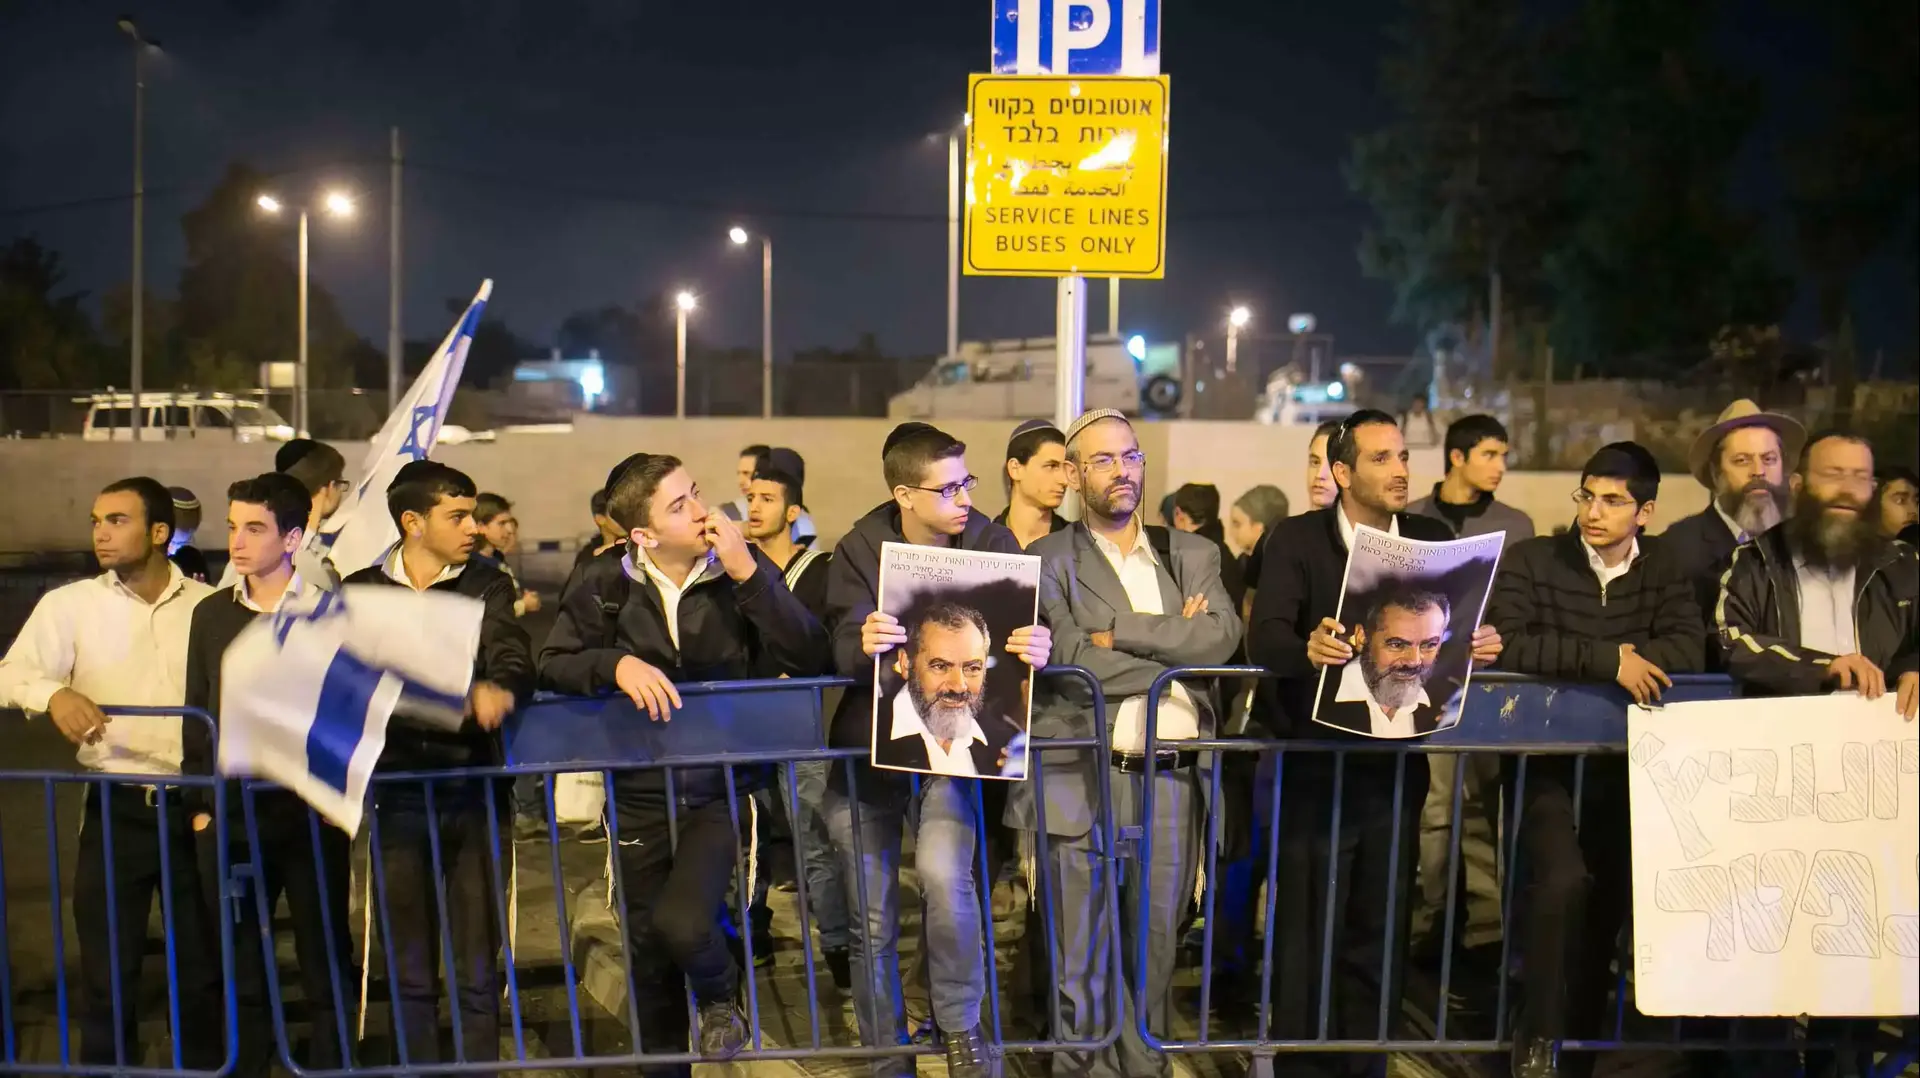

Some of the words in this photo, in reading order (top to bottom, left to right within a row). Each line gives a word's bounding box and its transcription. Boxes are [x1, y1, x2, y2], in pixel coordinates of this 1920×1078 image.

[988, 97, 1036, 120] בקווי
[1050, 97, 1152, 116] אוטובוסים
[1002, 119, 1059, 143] בלבד
[985, 207, 1076, 225] SERVICE
[1088, 208, 1150, 226] LINES
[995, 234, 1066, 253] BUSES
[1080, 236, 1137, 254] ONLY
